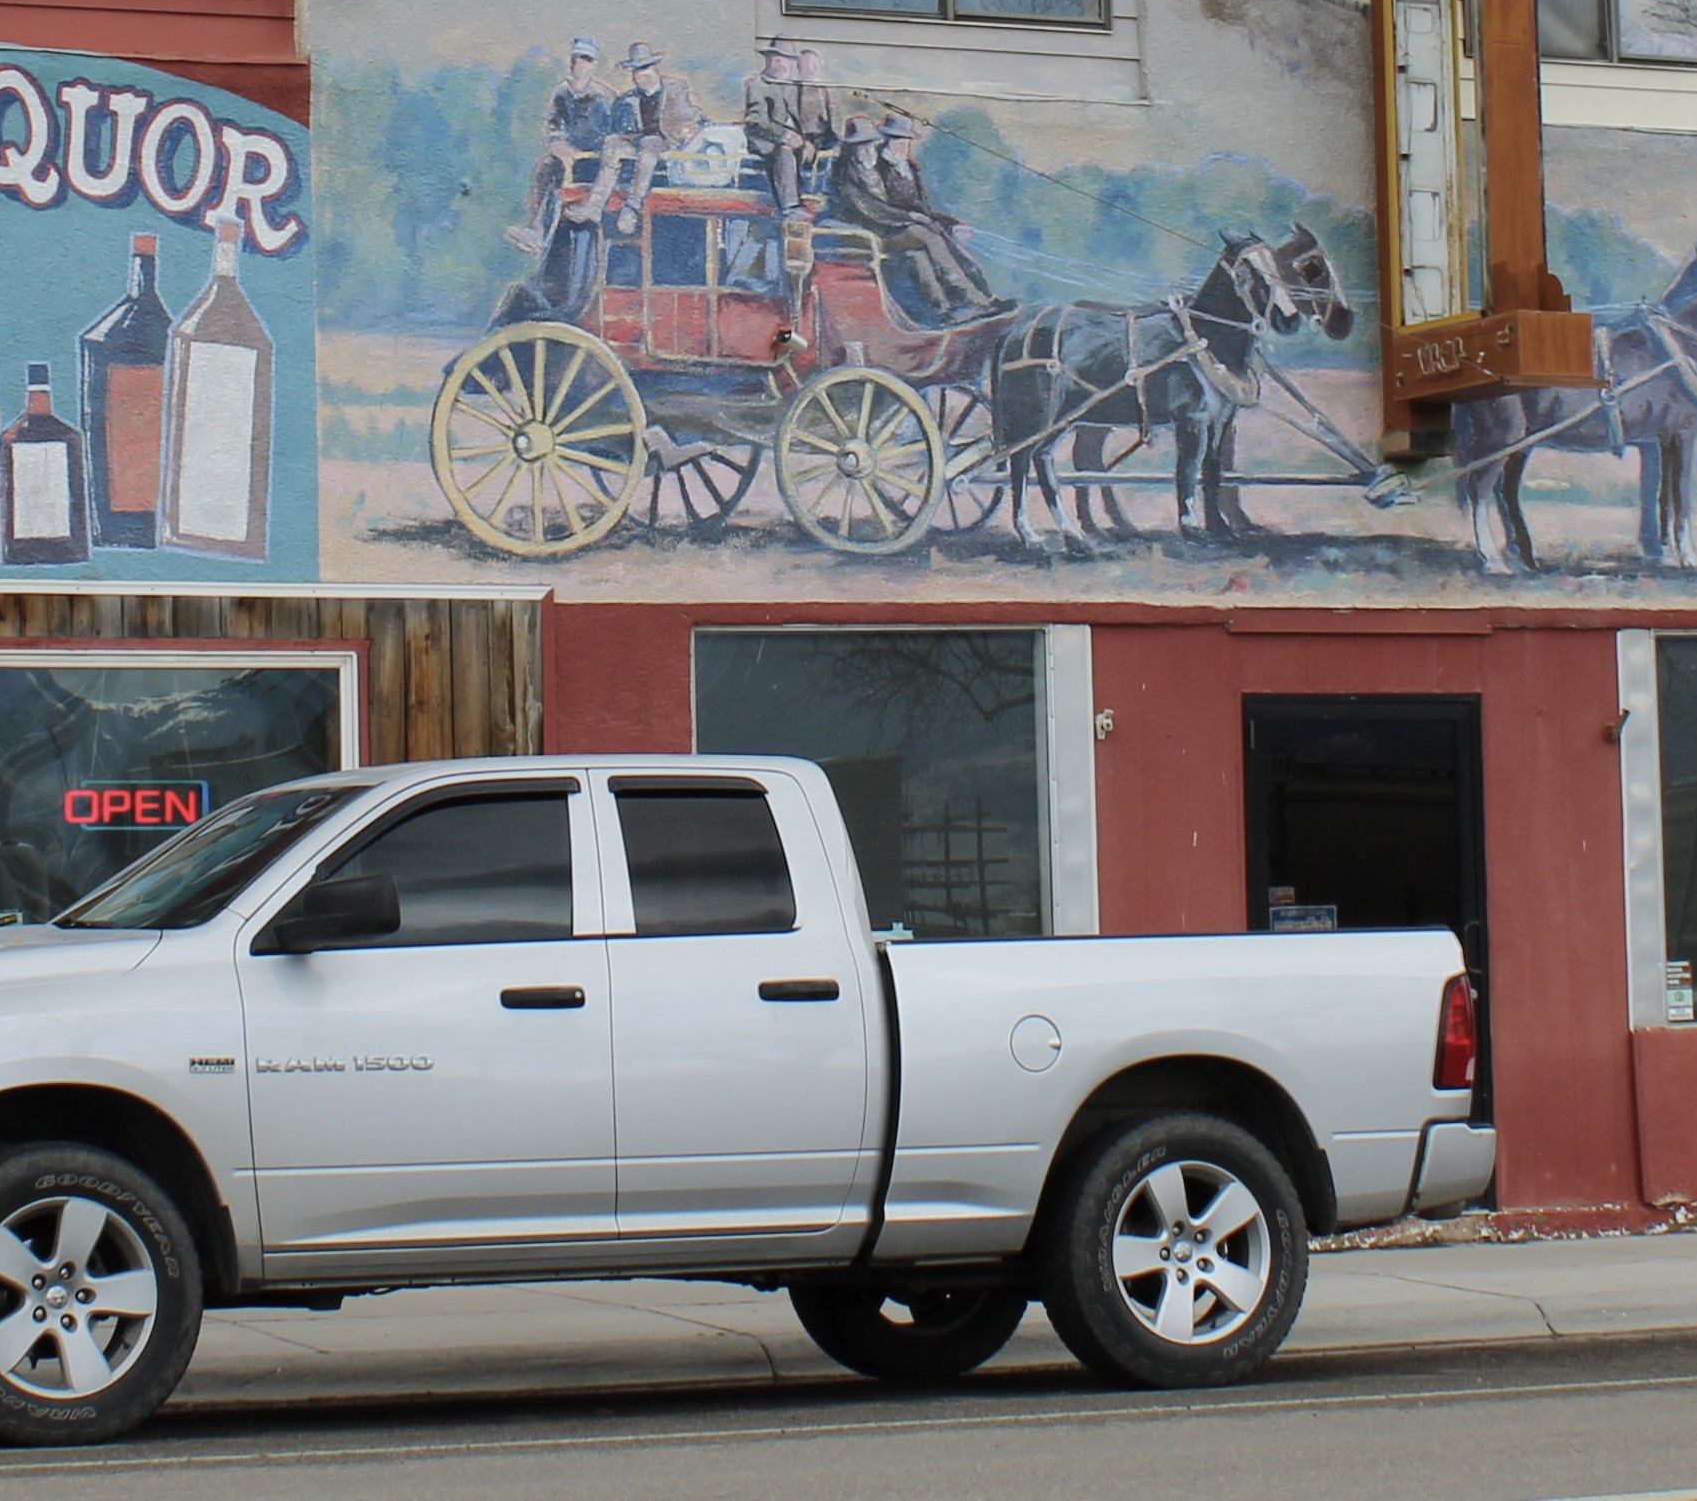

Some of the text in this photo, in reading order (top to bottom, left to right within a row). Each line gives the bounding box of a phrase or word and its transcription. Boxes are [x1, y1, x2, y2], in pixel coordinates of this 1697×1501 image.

[64, 789, 197, 823] OPEN
[190, 1057, 235, 1066] HEMI
[256, 1054, 434, 1073] RAM 1500
